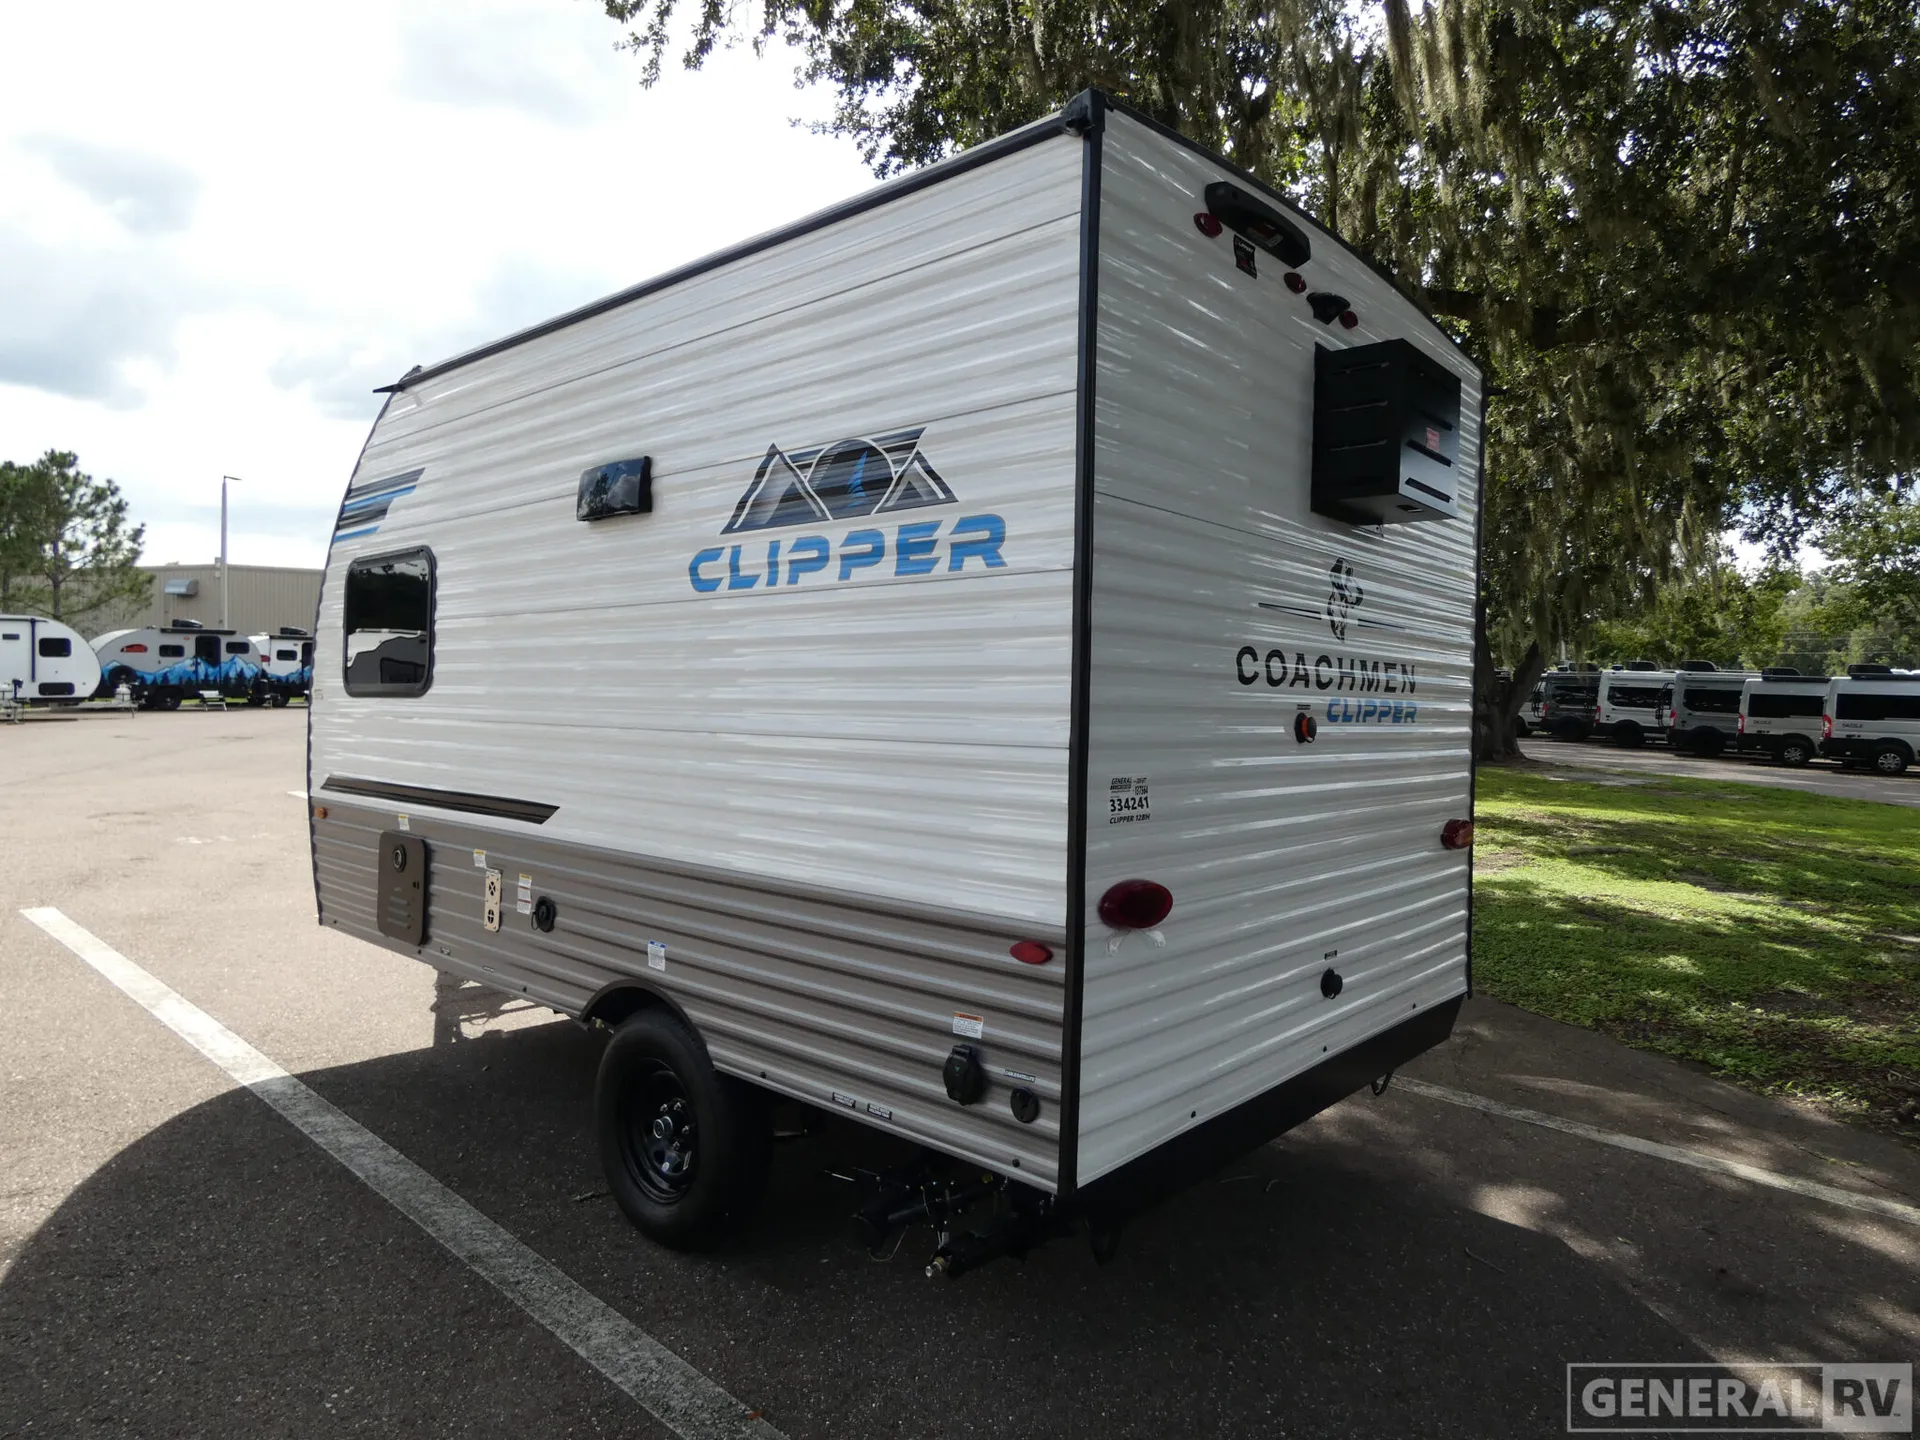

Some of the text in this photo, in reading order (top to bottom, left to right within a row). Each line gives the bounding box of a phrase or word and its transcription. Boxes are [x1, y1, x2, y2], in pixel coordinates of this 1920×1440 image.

[688, 513, 1008, 593] CLIPPER
[1236, 645, 1416, 694] COACHMEN
[1327, 698, 1418, 723] CLIPPER
[1110, 796, 1149, 812] 334241
[1110, 815, 1134, 824] CLIPPER
